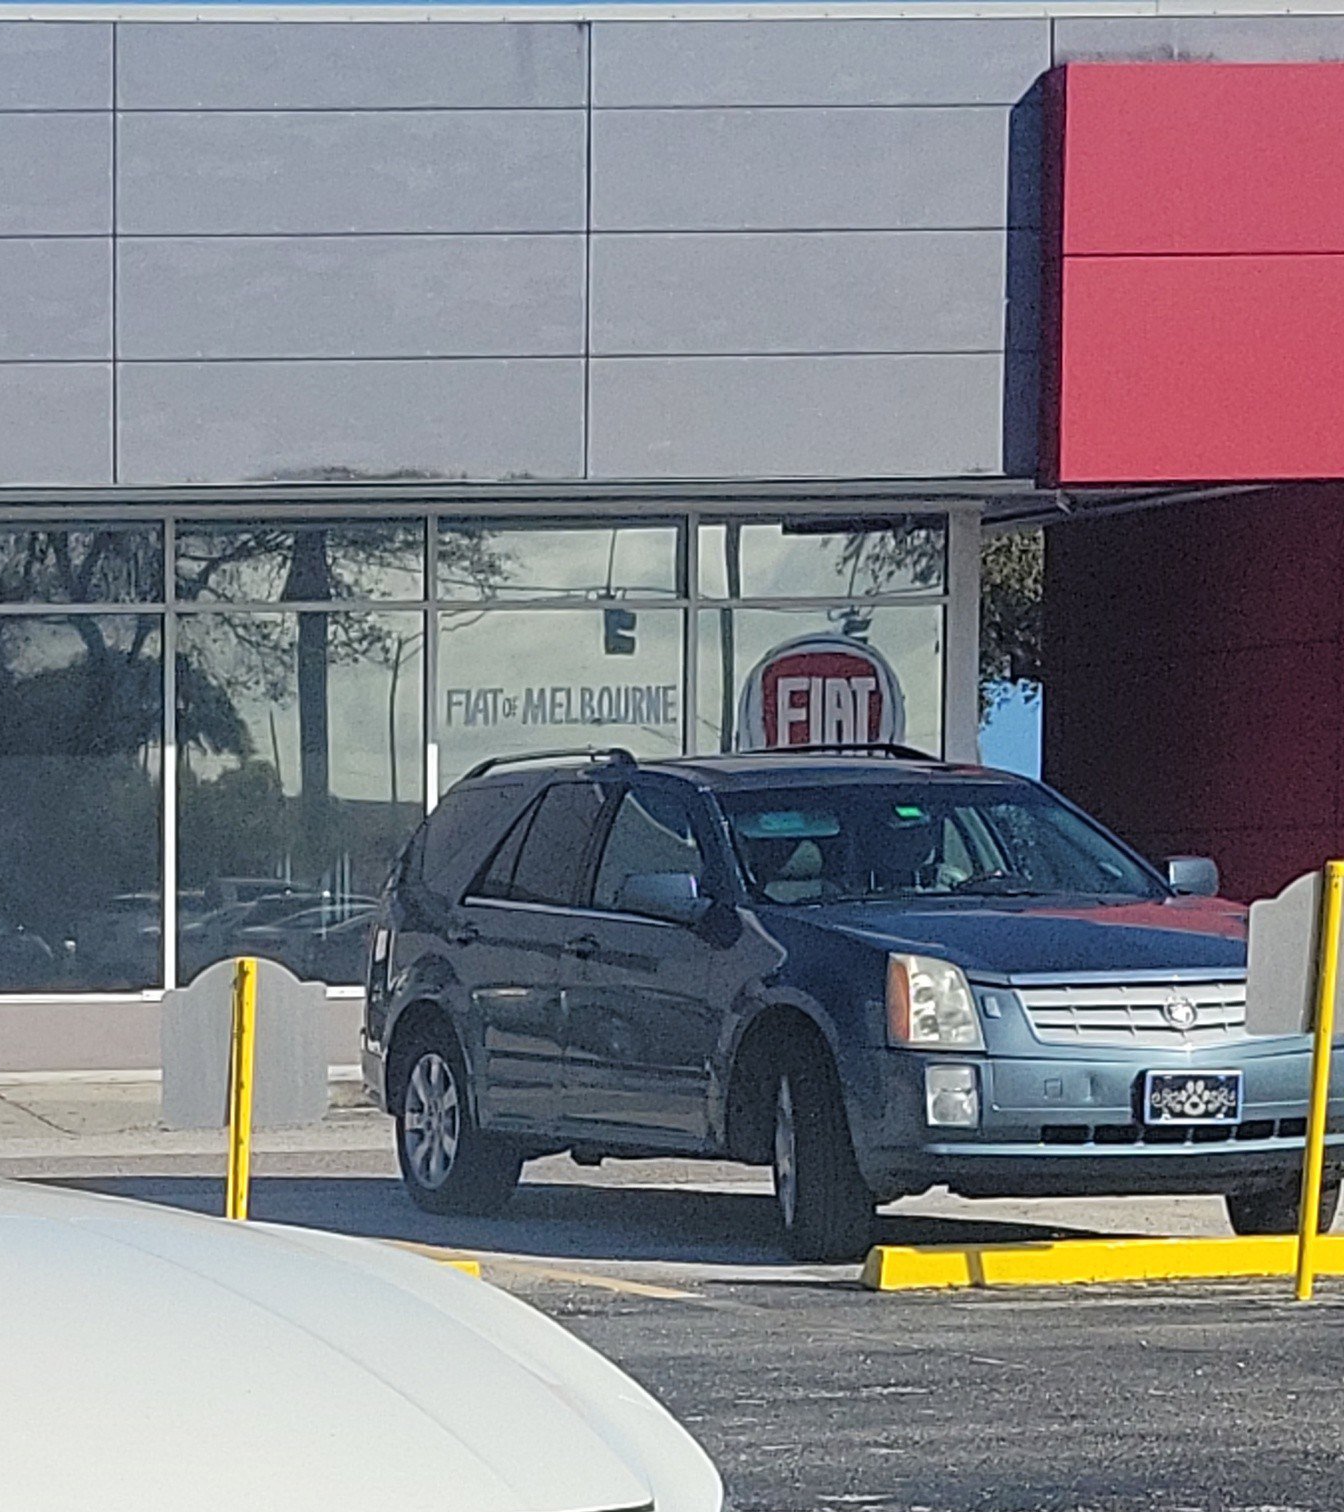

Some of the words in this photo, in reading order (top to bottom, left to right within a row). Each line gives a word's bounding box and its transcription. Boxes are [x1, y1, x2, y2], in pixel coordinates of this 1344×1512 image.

[446, 687, 503, 727] FIAT
[521, 684, 678, 726] MELBOURNE
[777, 675, 877, 749] FIAT
